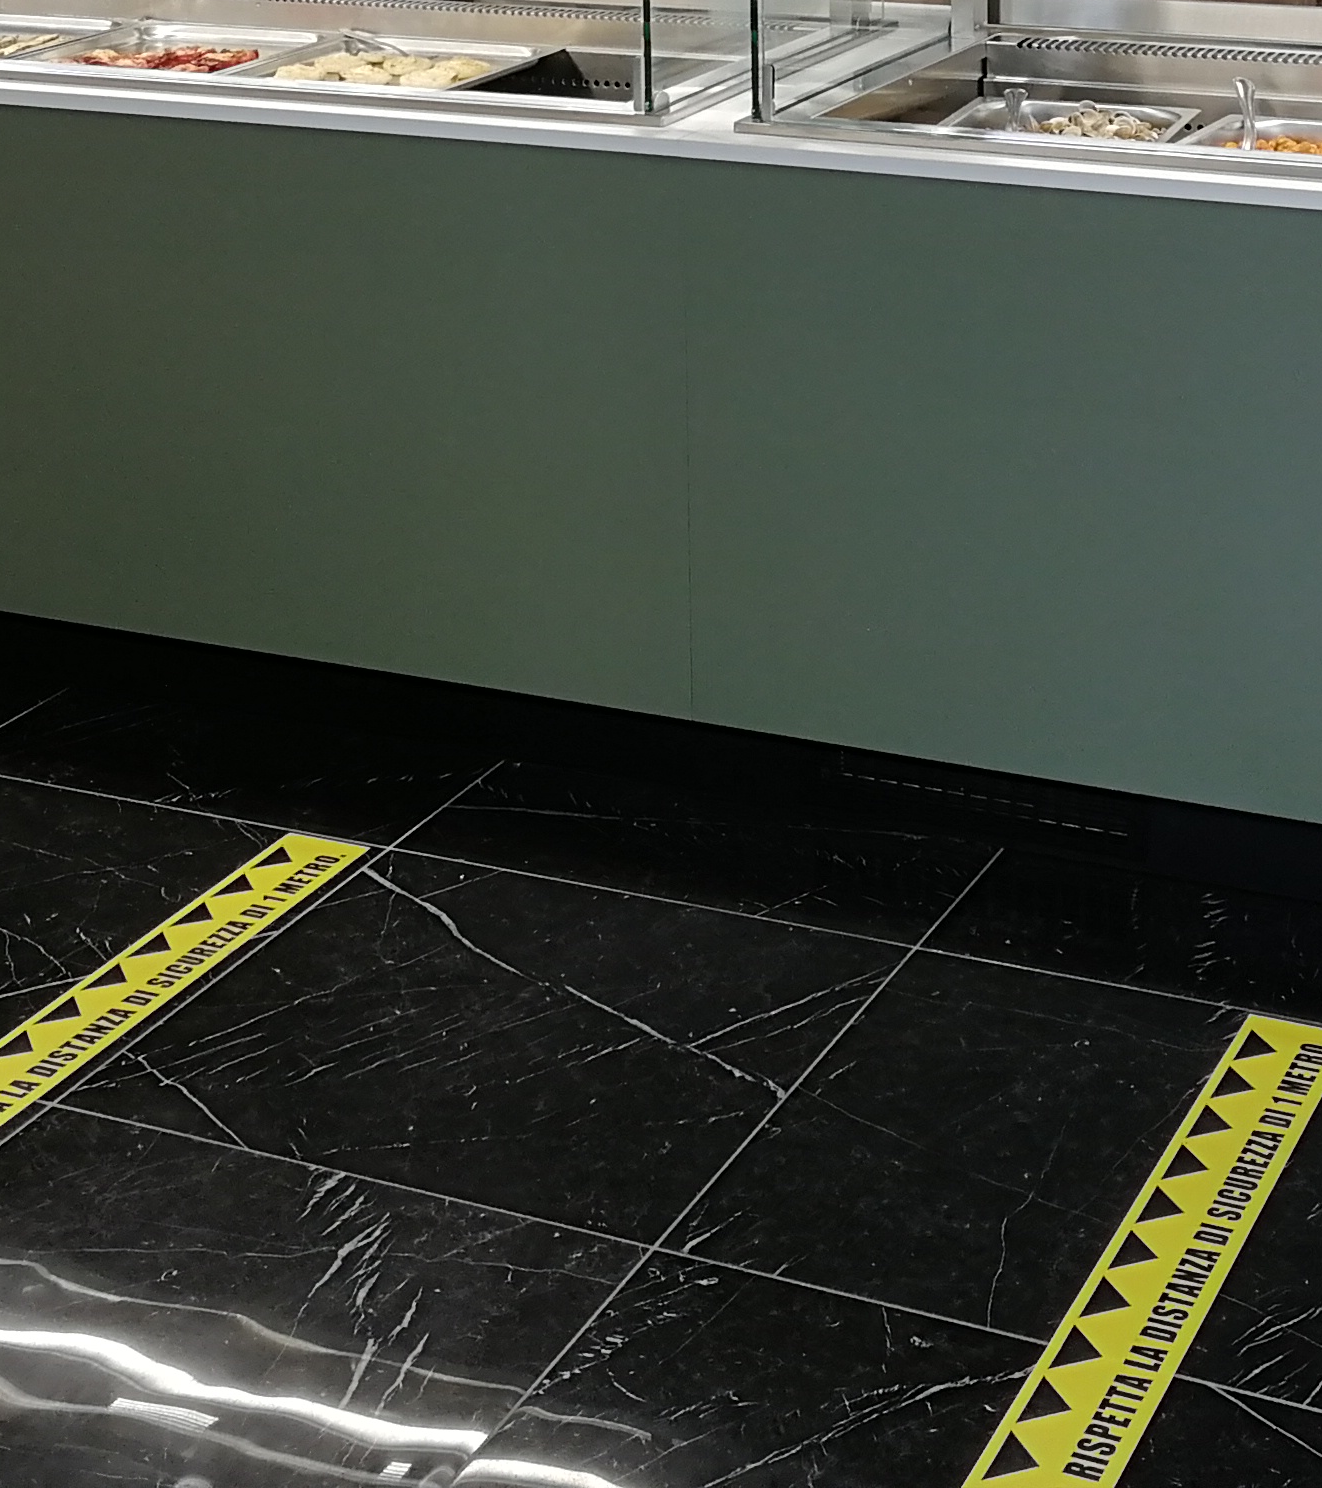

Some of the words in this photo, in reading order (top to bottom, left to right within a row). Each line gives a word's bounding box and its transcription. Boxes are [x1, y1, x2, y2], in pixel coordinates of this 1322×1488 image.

[271, 854, 348, 895] METRO.
[239, 903, 277, 919] DI
[262, 895, 288, 903] 1
[146, 920, 256, 989] SICUREZZA
[121, 989, 160, 1007] DI
[25, 1007, 138, 1079] DISTANZA
[1271, 1095, 1303, 1107] 1
[1258, 1107, 1297, 1129] DI
[1206, 1129, 1286, 1222] SICUREZZA
[1192, 1222, 1235, 1247] DI
[1139, 1247, 1223, 1344] DISTANZA
[1123, 1344, 1170, 1373] LA
[1062, 1374, 1154, 1482] RISPETTA
